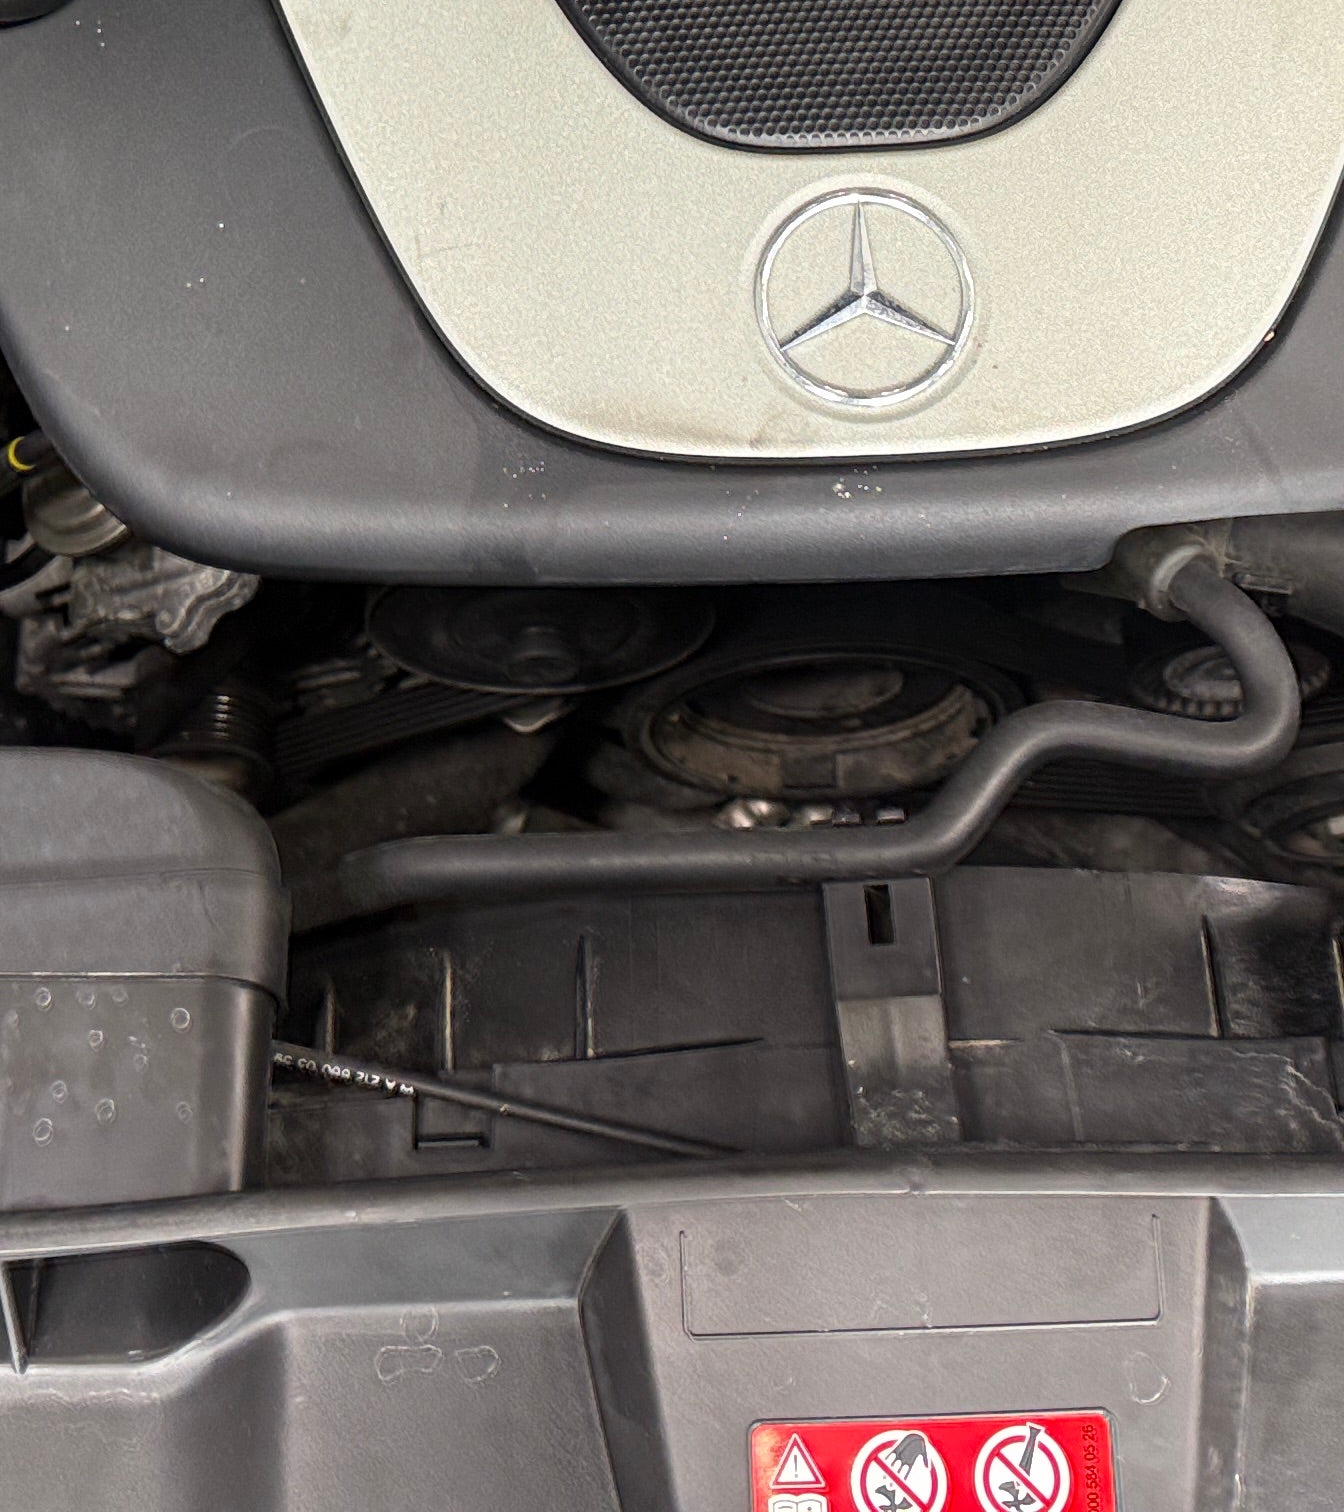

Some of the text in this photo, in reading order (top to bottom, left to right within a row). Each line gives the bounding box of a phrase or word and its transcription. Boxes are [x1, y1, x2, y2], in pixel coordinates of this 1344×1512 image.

[1082, 1424, 1095, 1441] 26
[1083, 1444, 1097, 1462] 05
[1085, 1464, 1098, 1490] 584
